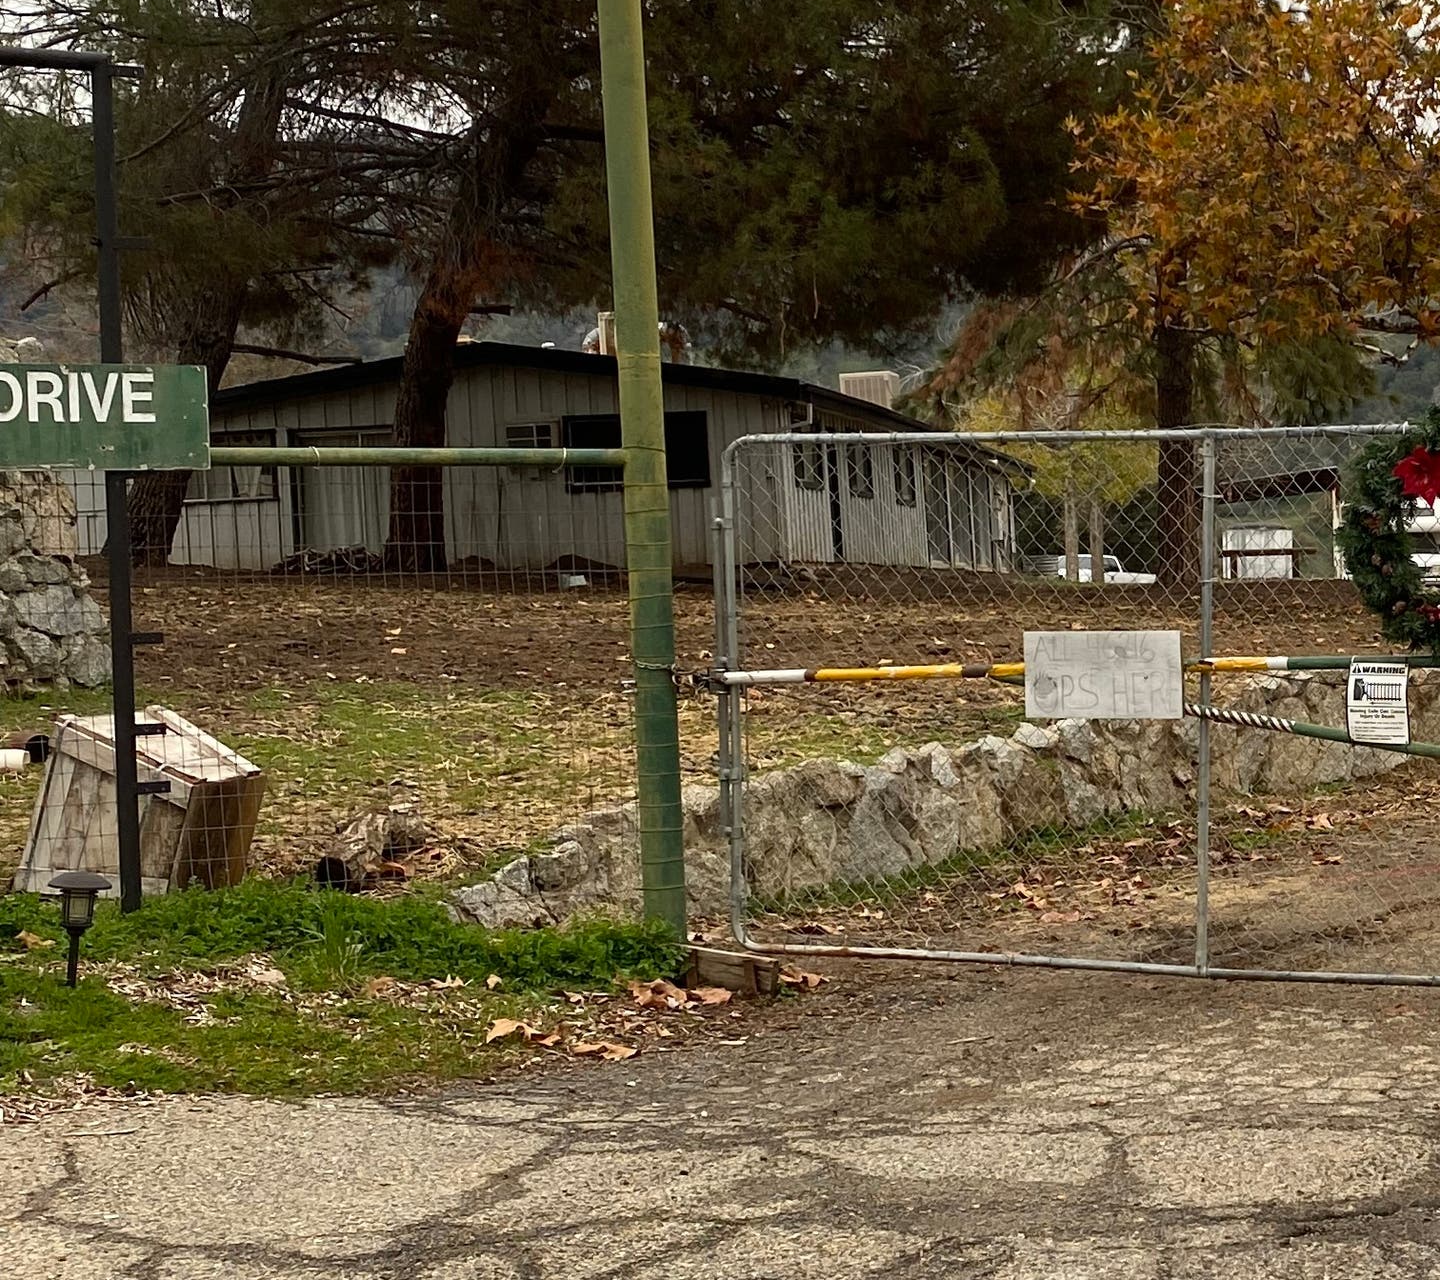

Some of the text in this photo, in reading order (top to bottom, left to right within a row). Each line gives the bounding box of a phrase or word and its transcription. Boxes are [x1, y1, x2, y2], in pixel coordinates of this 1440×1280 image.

[0, 371, 156, 423] DRIVE
[1113, 670, 1179, 714] HERE
[1362, 666, 1405, 674] WARNING
